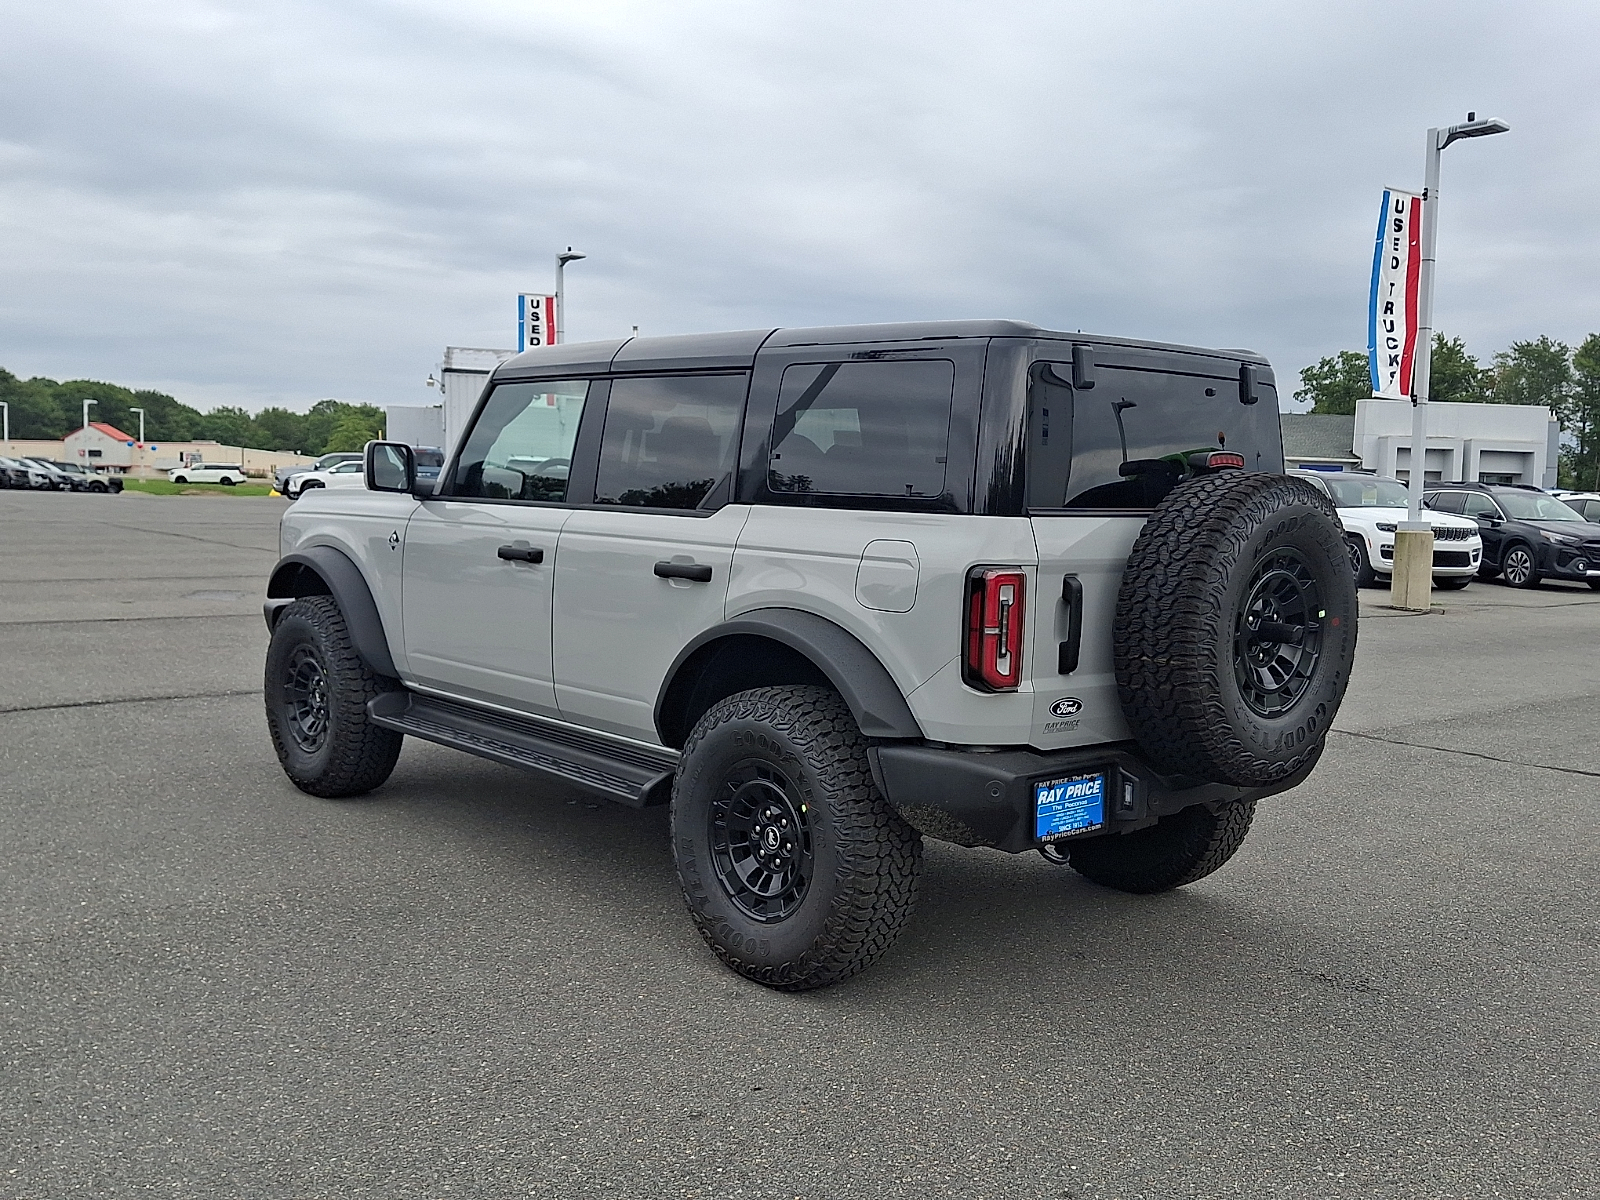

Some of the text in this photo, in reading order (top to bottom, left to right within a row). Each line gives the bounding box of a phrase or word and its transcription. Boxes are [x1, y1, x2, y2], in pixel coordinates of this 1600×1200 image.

[1391, 198, 1405, 270] USED
[530, 299, 541, 346] USED
[1044, 721, 1060, 730] RAY
[1038, 780, 1102, 805] RAY PRICE
[1059, 822, 1072, 832] SINCE
